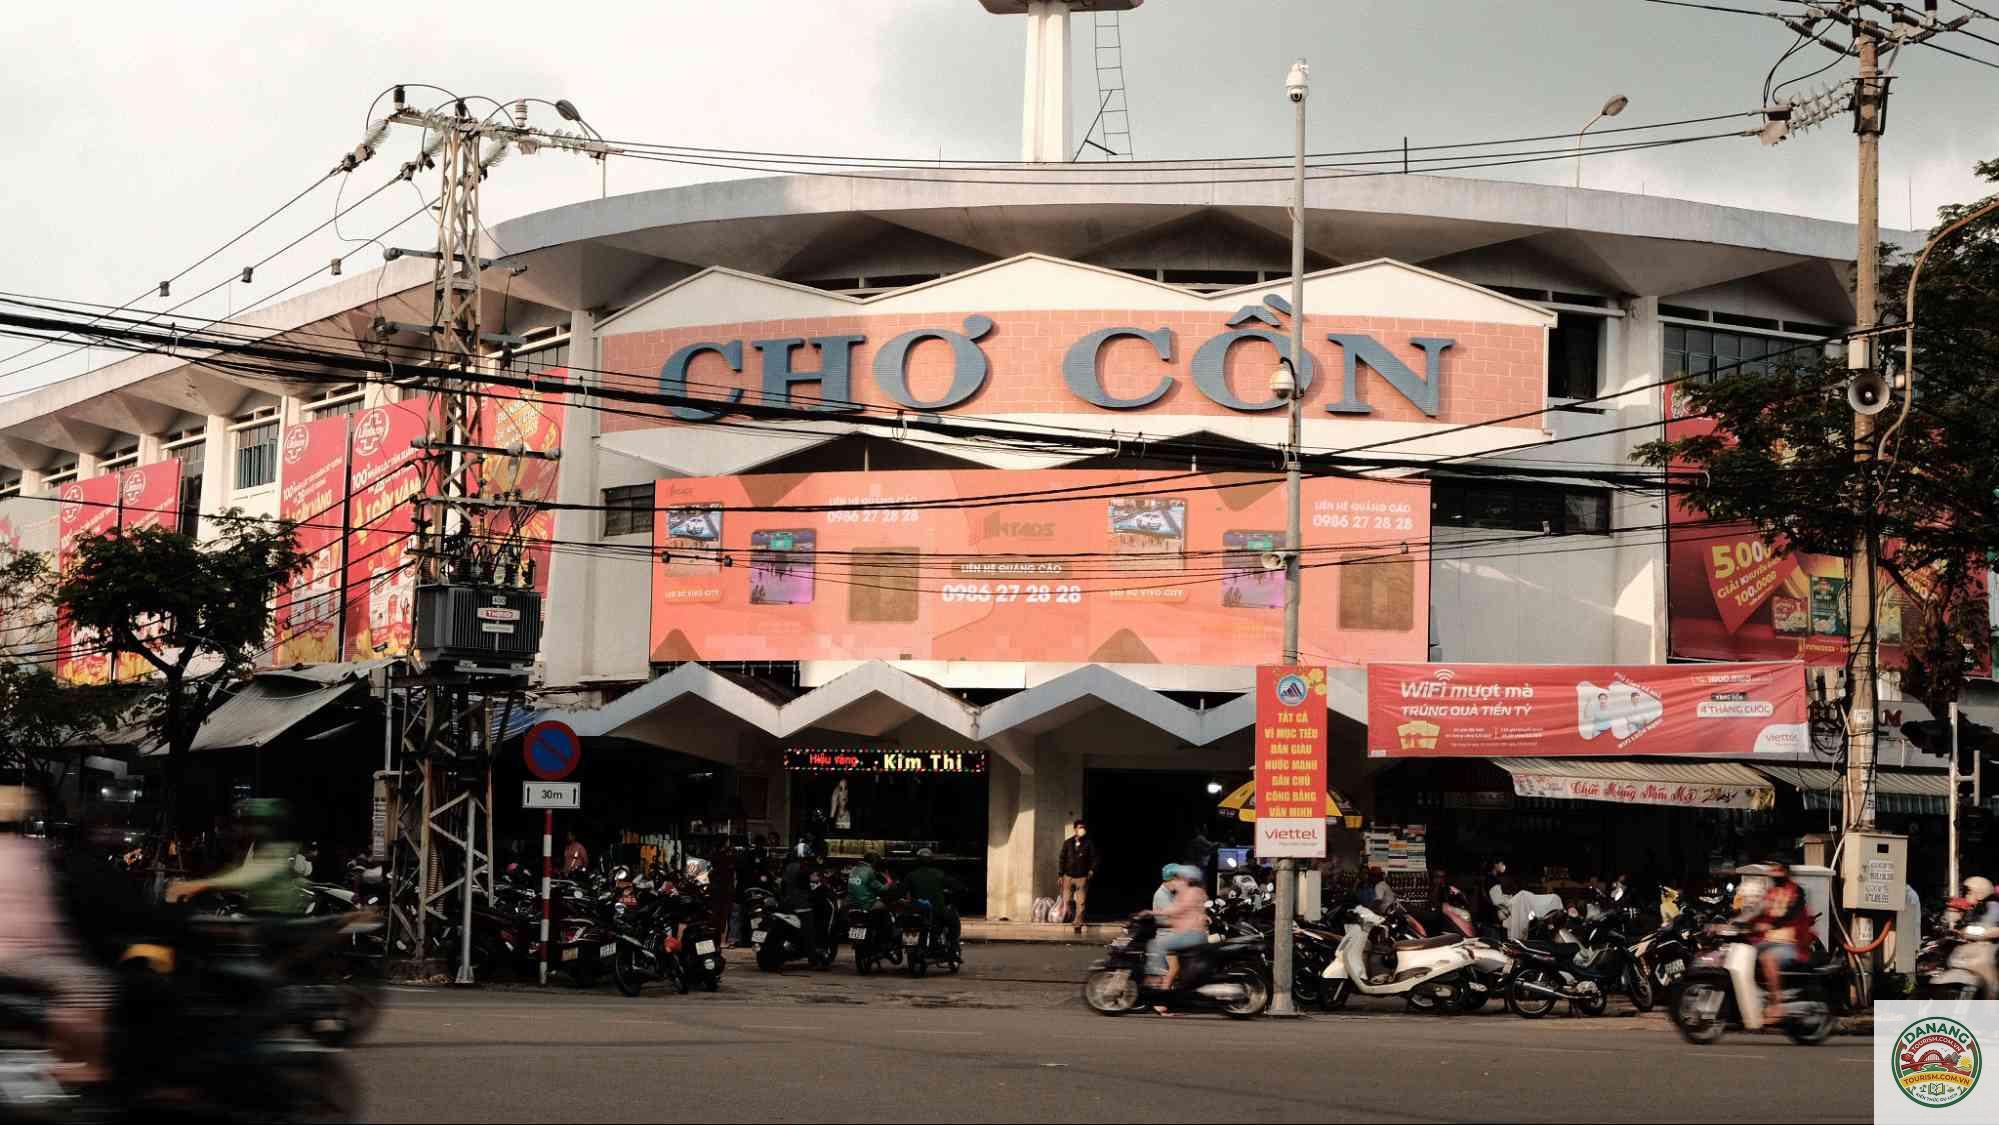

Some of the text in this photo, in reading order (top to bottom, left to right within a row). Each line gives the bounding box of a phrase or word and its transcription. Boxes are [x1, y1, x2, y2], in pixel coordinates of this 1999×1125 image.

[658, 293, 1455, 425] CHỢ CỒN
[1352, 516, 1370, 529] 27
[943, 584, 1082, 604] 0986 27 28 28
[1400, 681, 1534, 701] WiFi mượt mà
[1401, 703, 1448, 716] TRÚNG
[883, 754, 922, 769] Kim
[928, 754, 962, 770] Thi
[541, 789, 563, 800] 30m
[1264, 826, 1319, 841] viettel
